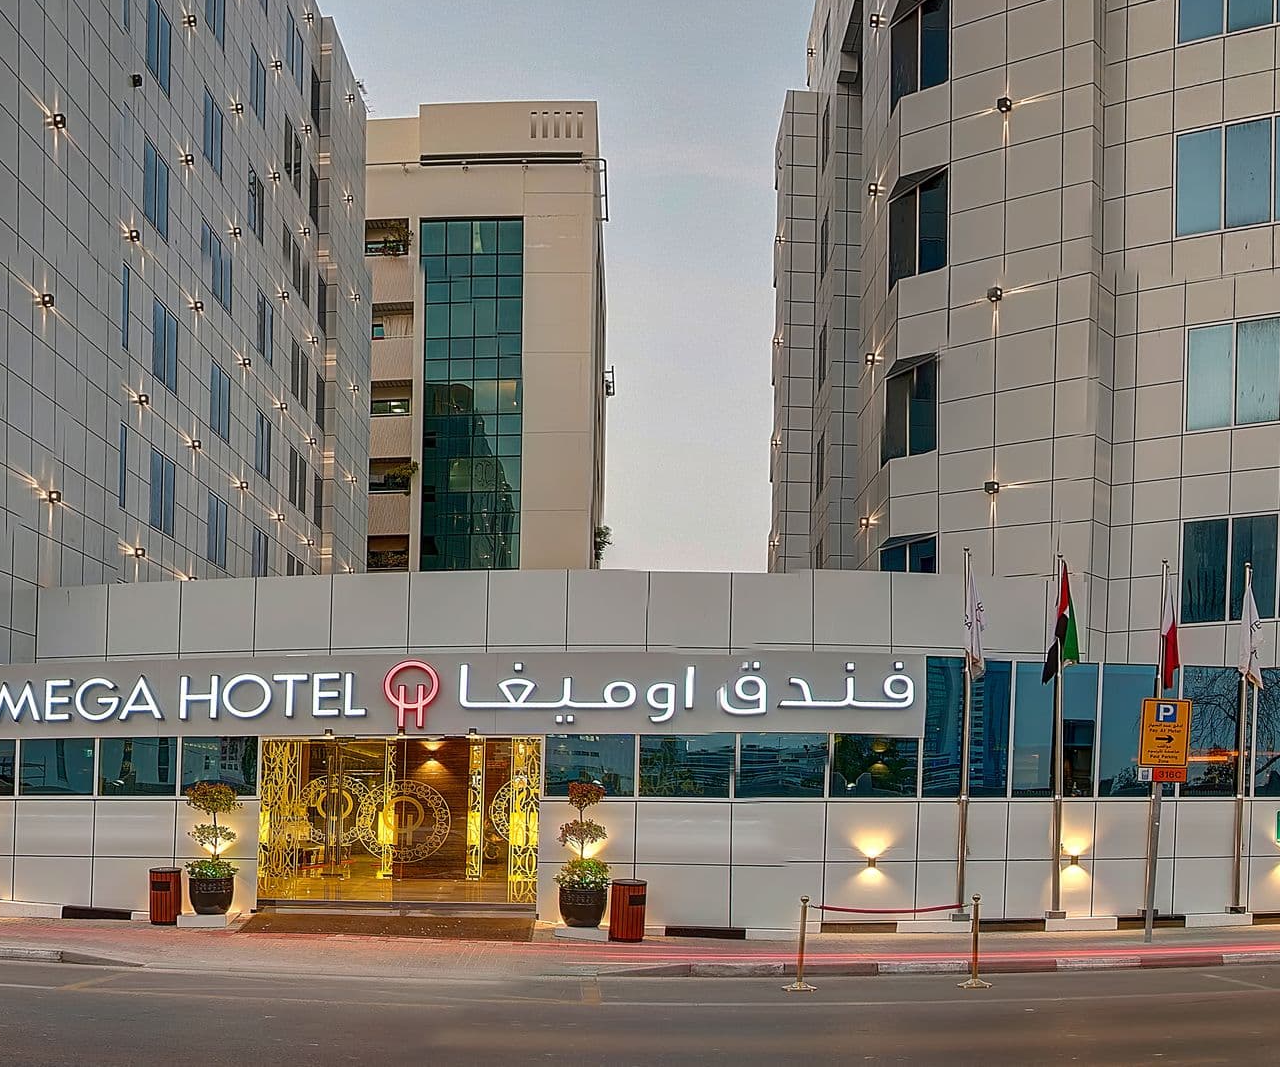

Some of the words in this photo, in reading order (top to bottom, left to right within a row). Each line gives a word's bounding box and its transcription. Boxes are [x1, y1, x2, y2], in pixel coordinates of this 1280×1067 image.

[179, 672, 367, 721] HOTEL
[459, 662, 696, 724] اوميغا
[716, 660, 916, 716] فندق
[1158, 704, 1175, 722] P
